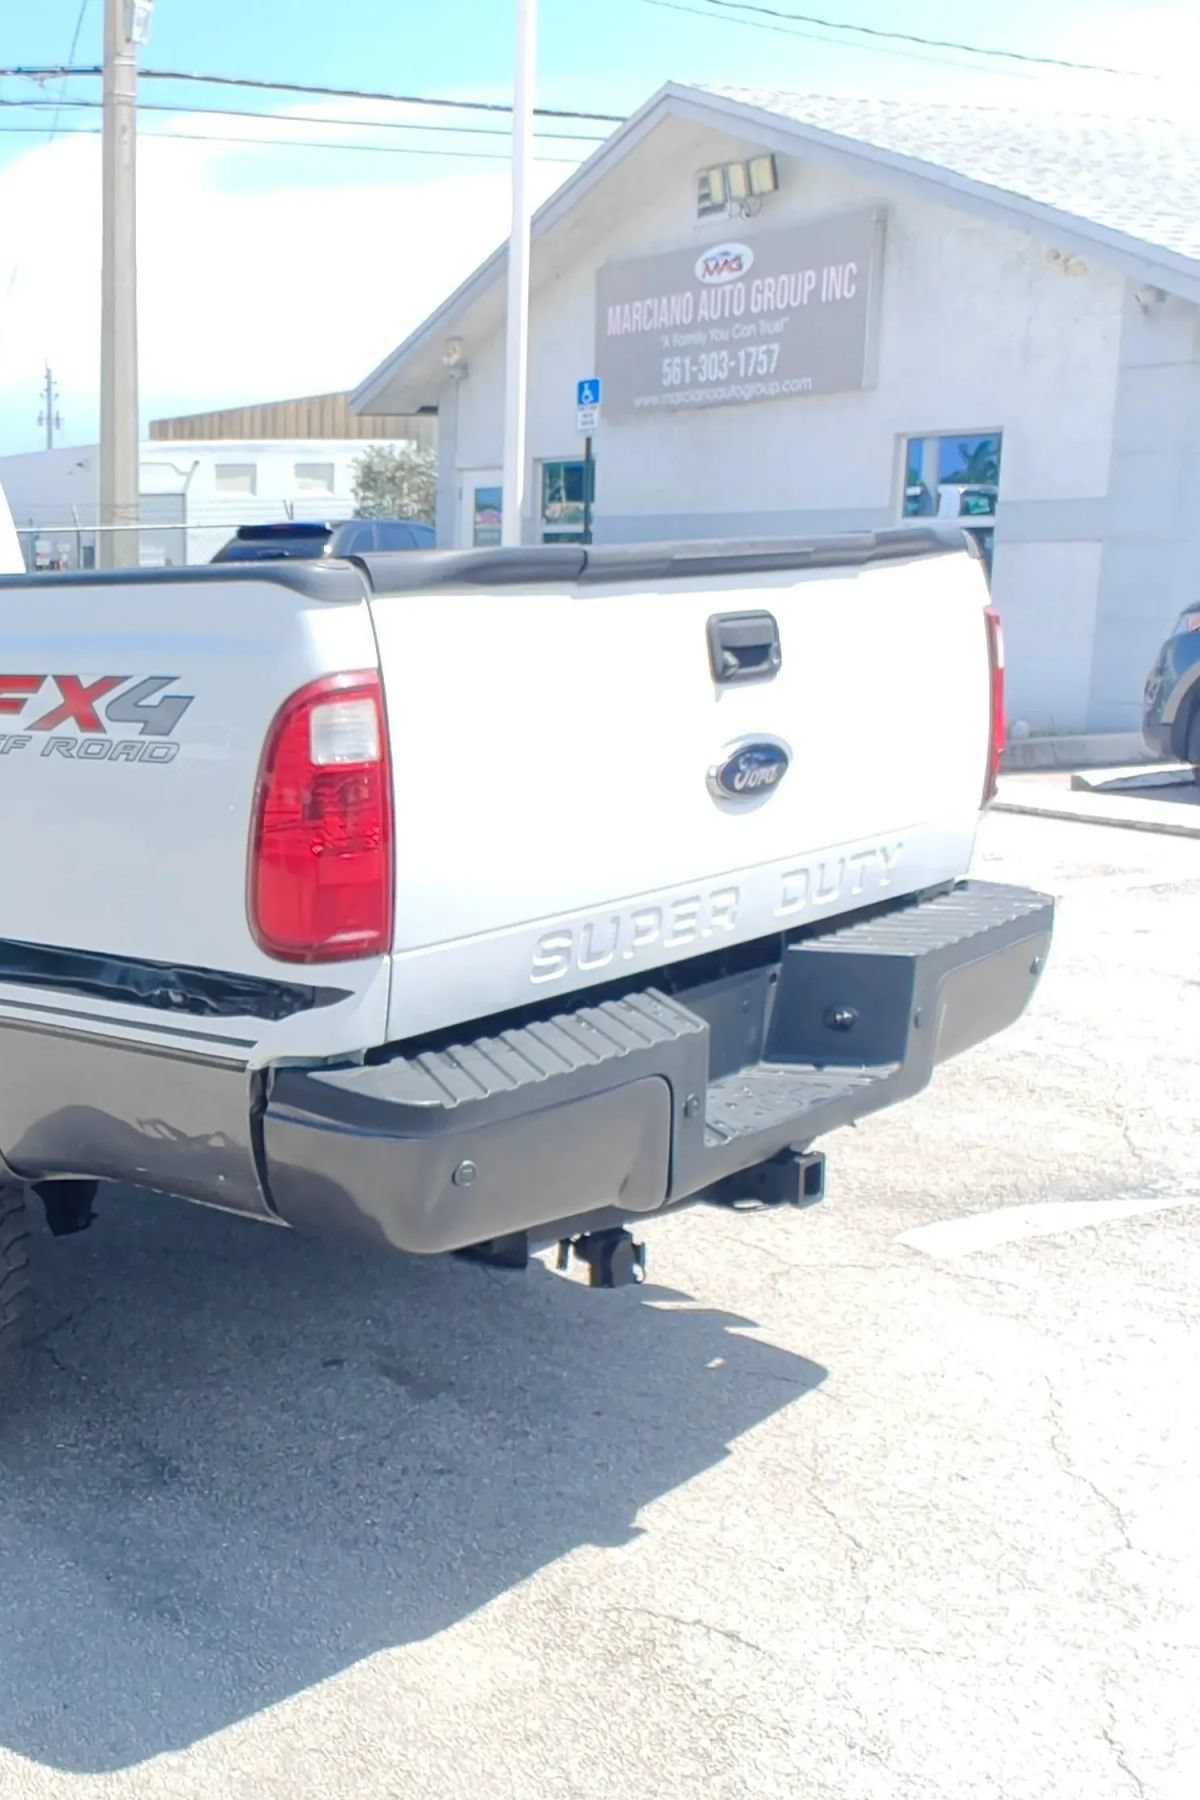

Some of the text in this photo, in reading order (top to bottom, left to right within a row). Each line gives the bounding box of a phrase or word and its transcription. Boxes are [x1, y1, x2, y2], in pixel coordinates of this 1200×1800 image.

[607, 261, 858, 337] MARCIANO AUTO GROUP INC
[708, 327, 730, 343] You
[731, 323, 757, 339] Can
[661, 342, 780, 387] 561-303-1757
[40, 736, 180, 764] ROAD
[734, 752, 780, 790] Ford
[529, 842, 904, 985] SUPER DUTY
